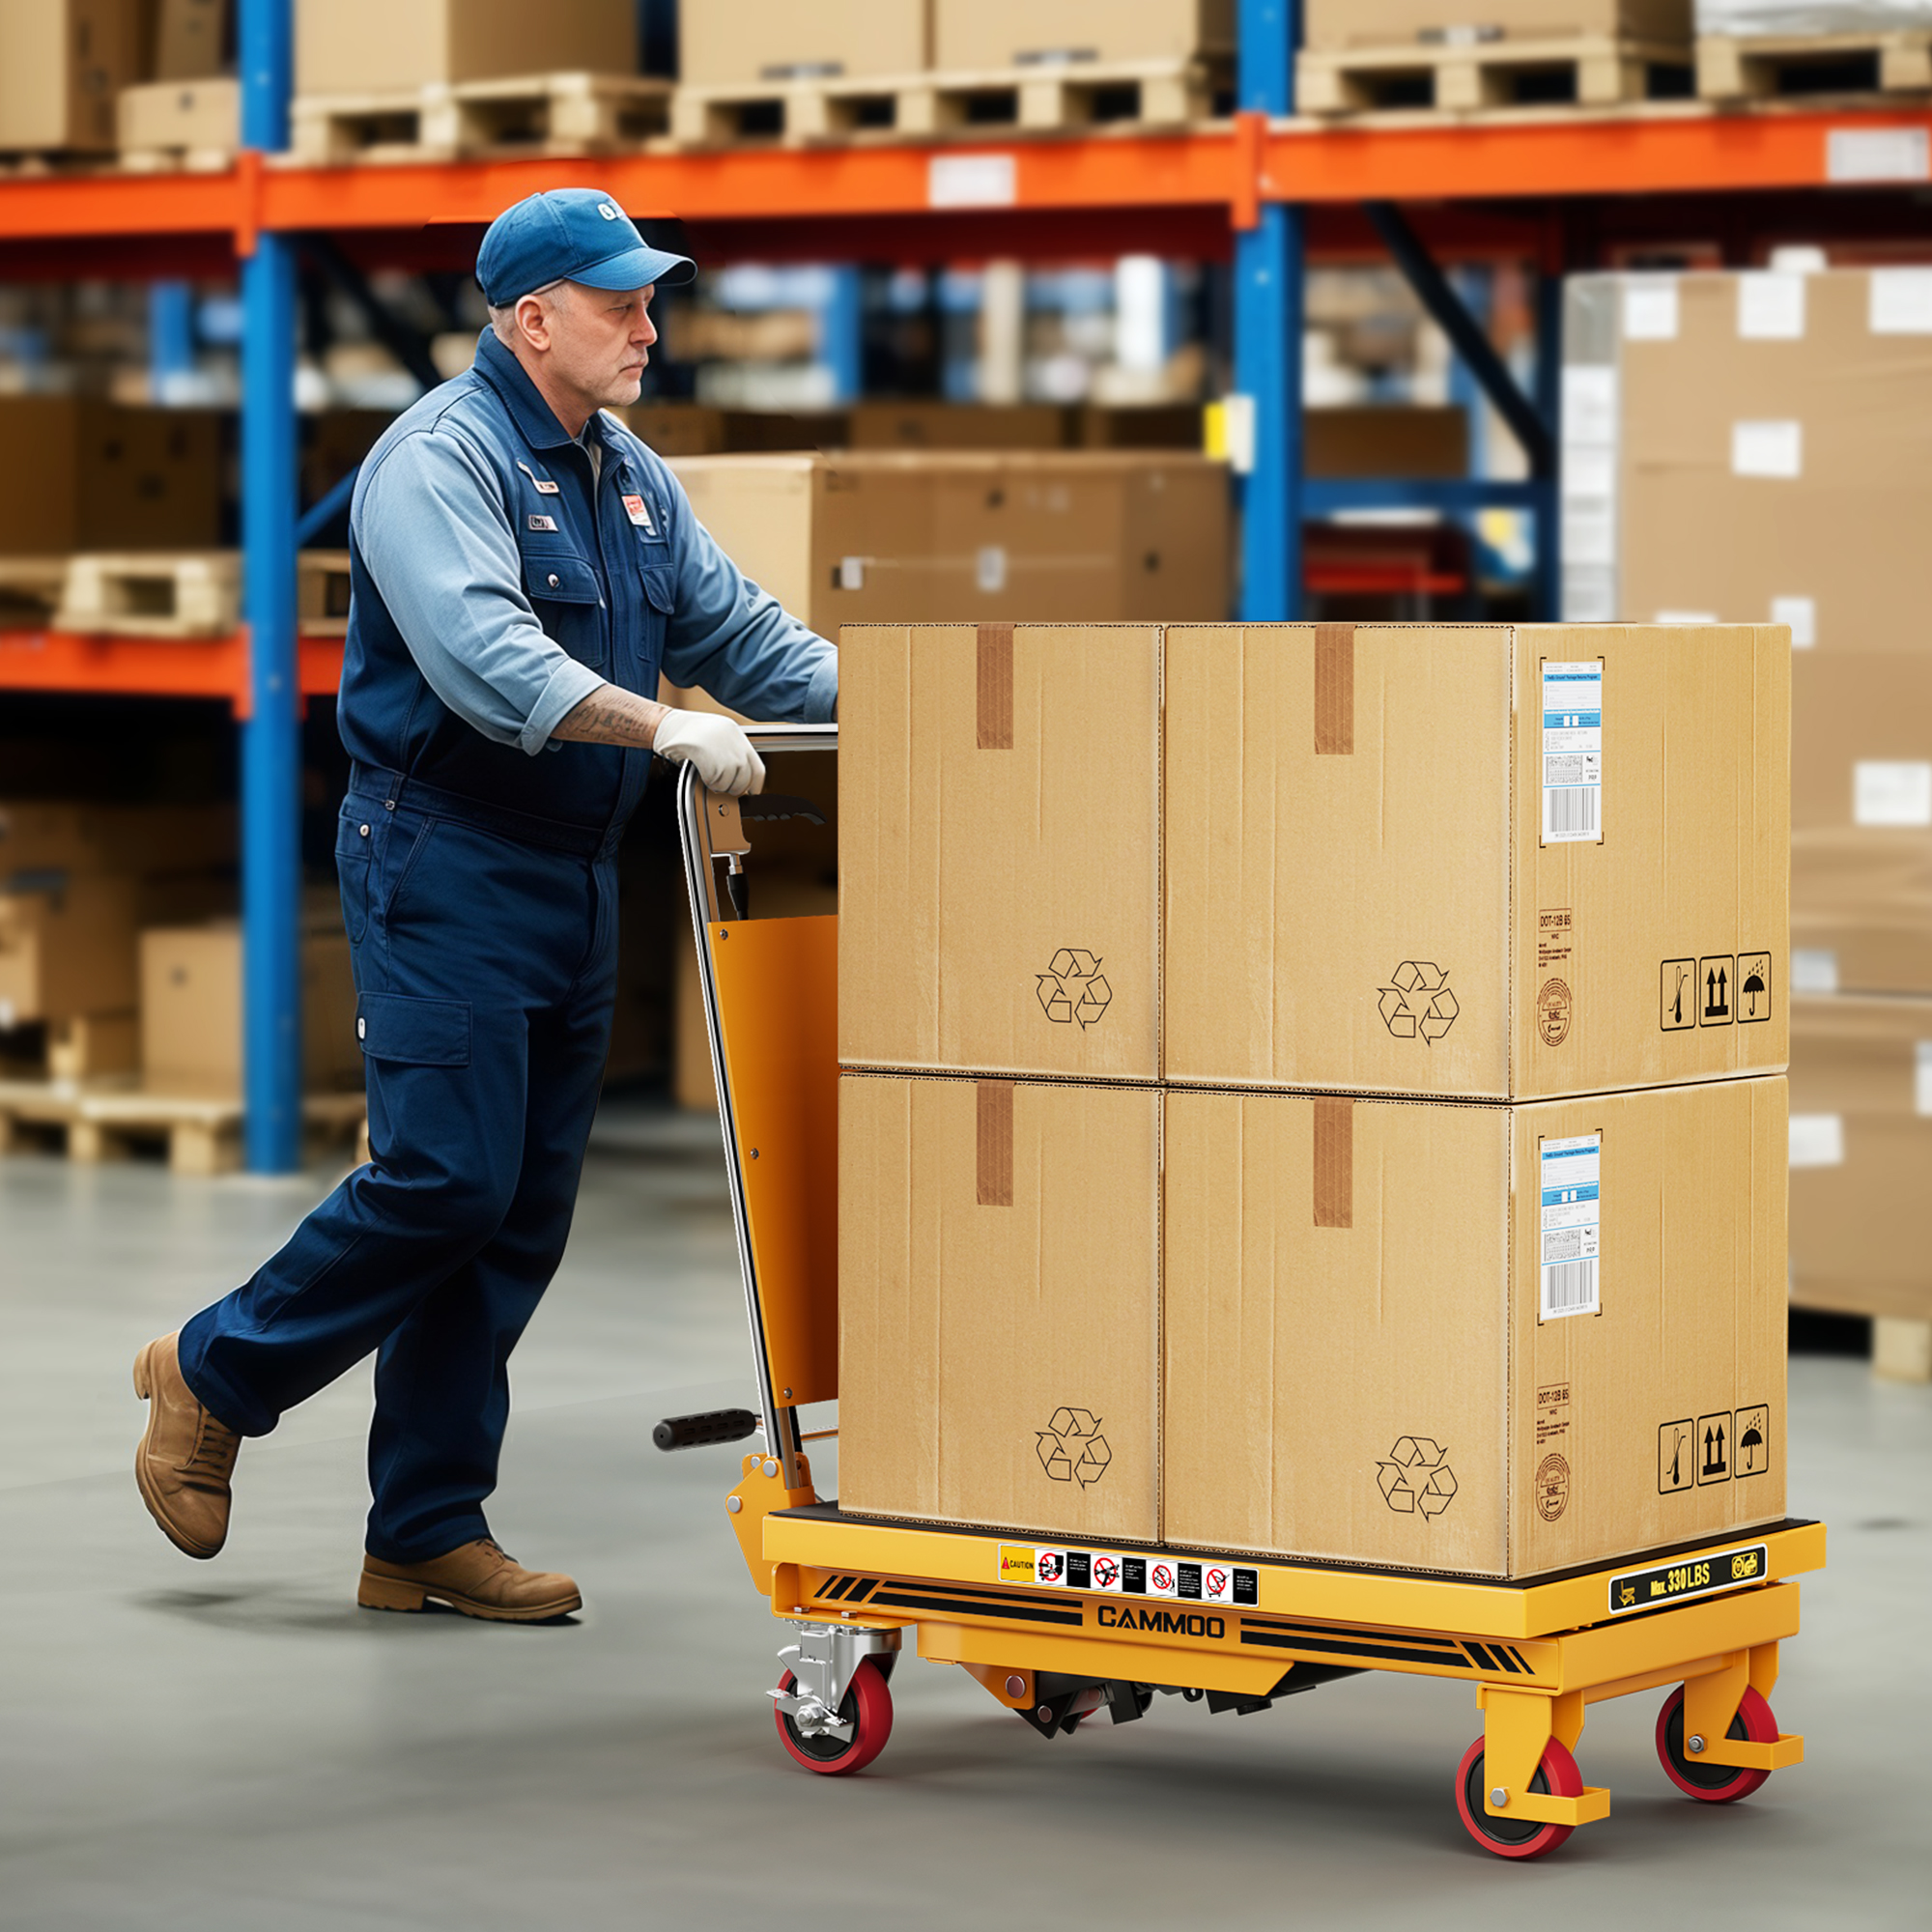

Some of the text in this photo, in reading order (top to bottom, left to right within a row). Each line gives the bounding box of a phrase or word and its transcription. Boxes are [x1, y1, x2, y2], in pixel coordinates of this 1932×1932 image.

[1009, 1559, 1035, 1570] CAUTION
[1650, 1579, 1667, 1597] Max.
[1097, 1605, 1225, 1639] CAMMOO
